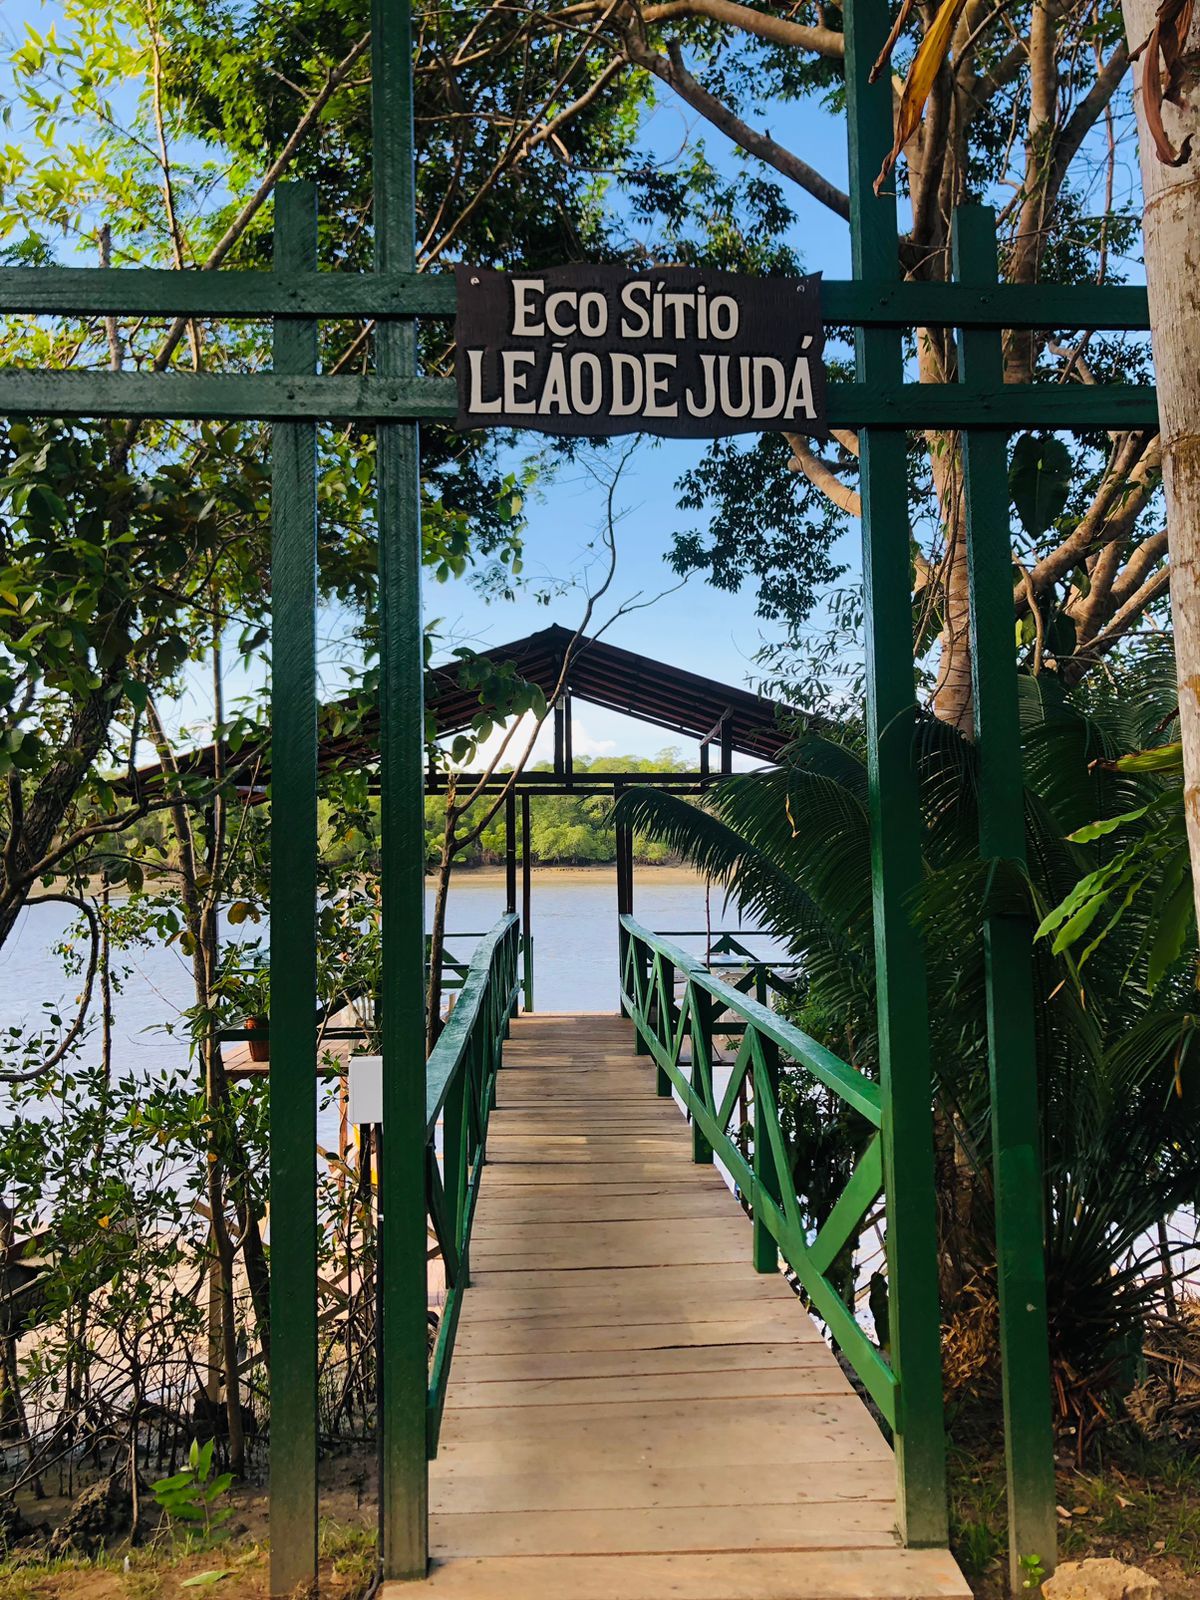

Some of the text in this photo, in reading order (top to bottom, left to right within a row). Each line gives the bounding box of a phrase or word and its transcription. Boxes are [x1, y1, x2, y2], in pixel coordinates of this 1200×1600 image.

[467, 335, 818, 420] LEÃO DE JUDÁ
